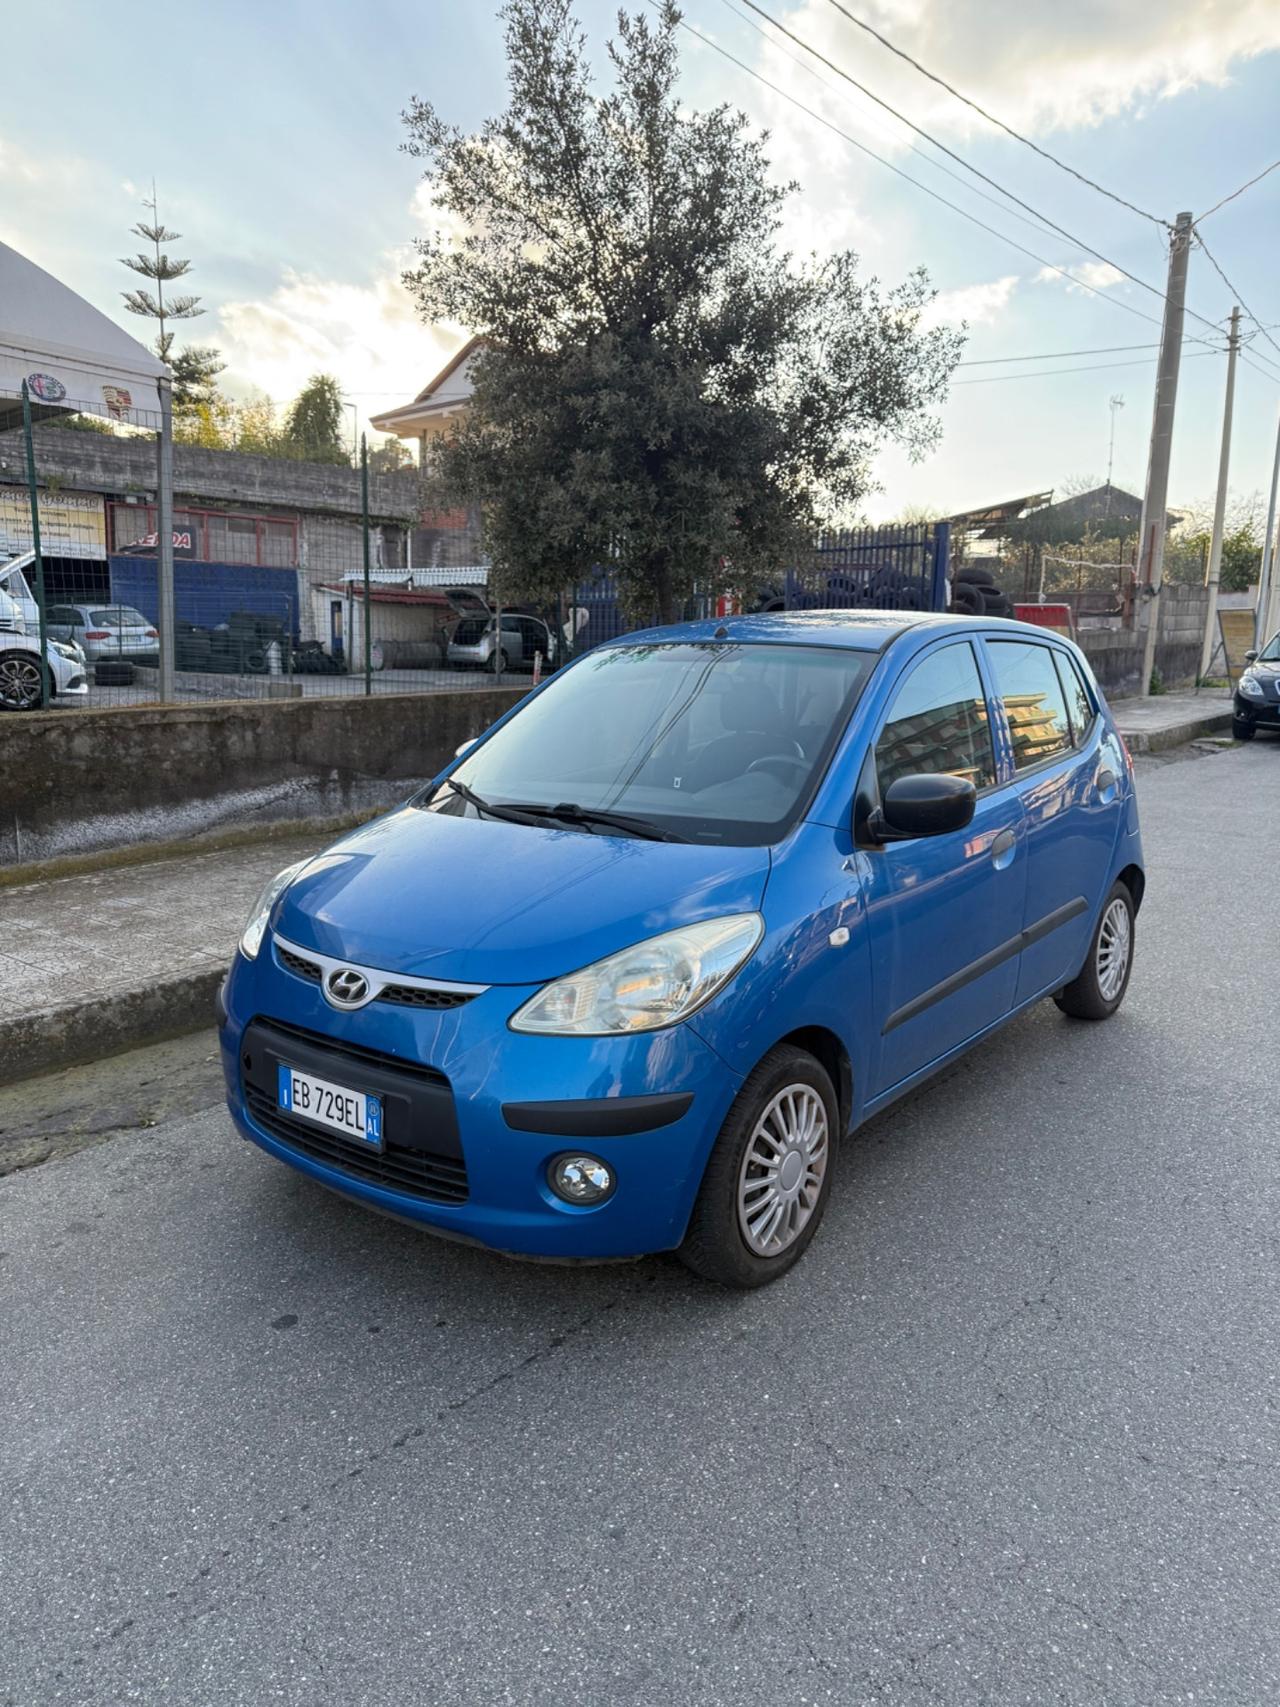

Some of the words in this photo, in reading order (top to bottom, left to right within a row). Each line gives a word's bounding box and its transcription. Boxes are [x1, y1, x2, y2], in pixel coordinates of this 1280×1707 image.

[40, 491, 99, 508] Gomme
[293, 1079, 310, 1109] EB
[315, 1087, 364, 1131] 729EL
[367, 1118, 379, 1136] AL
